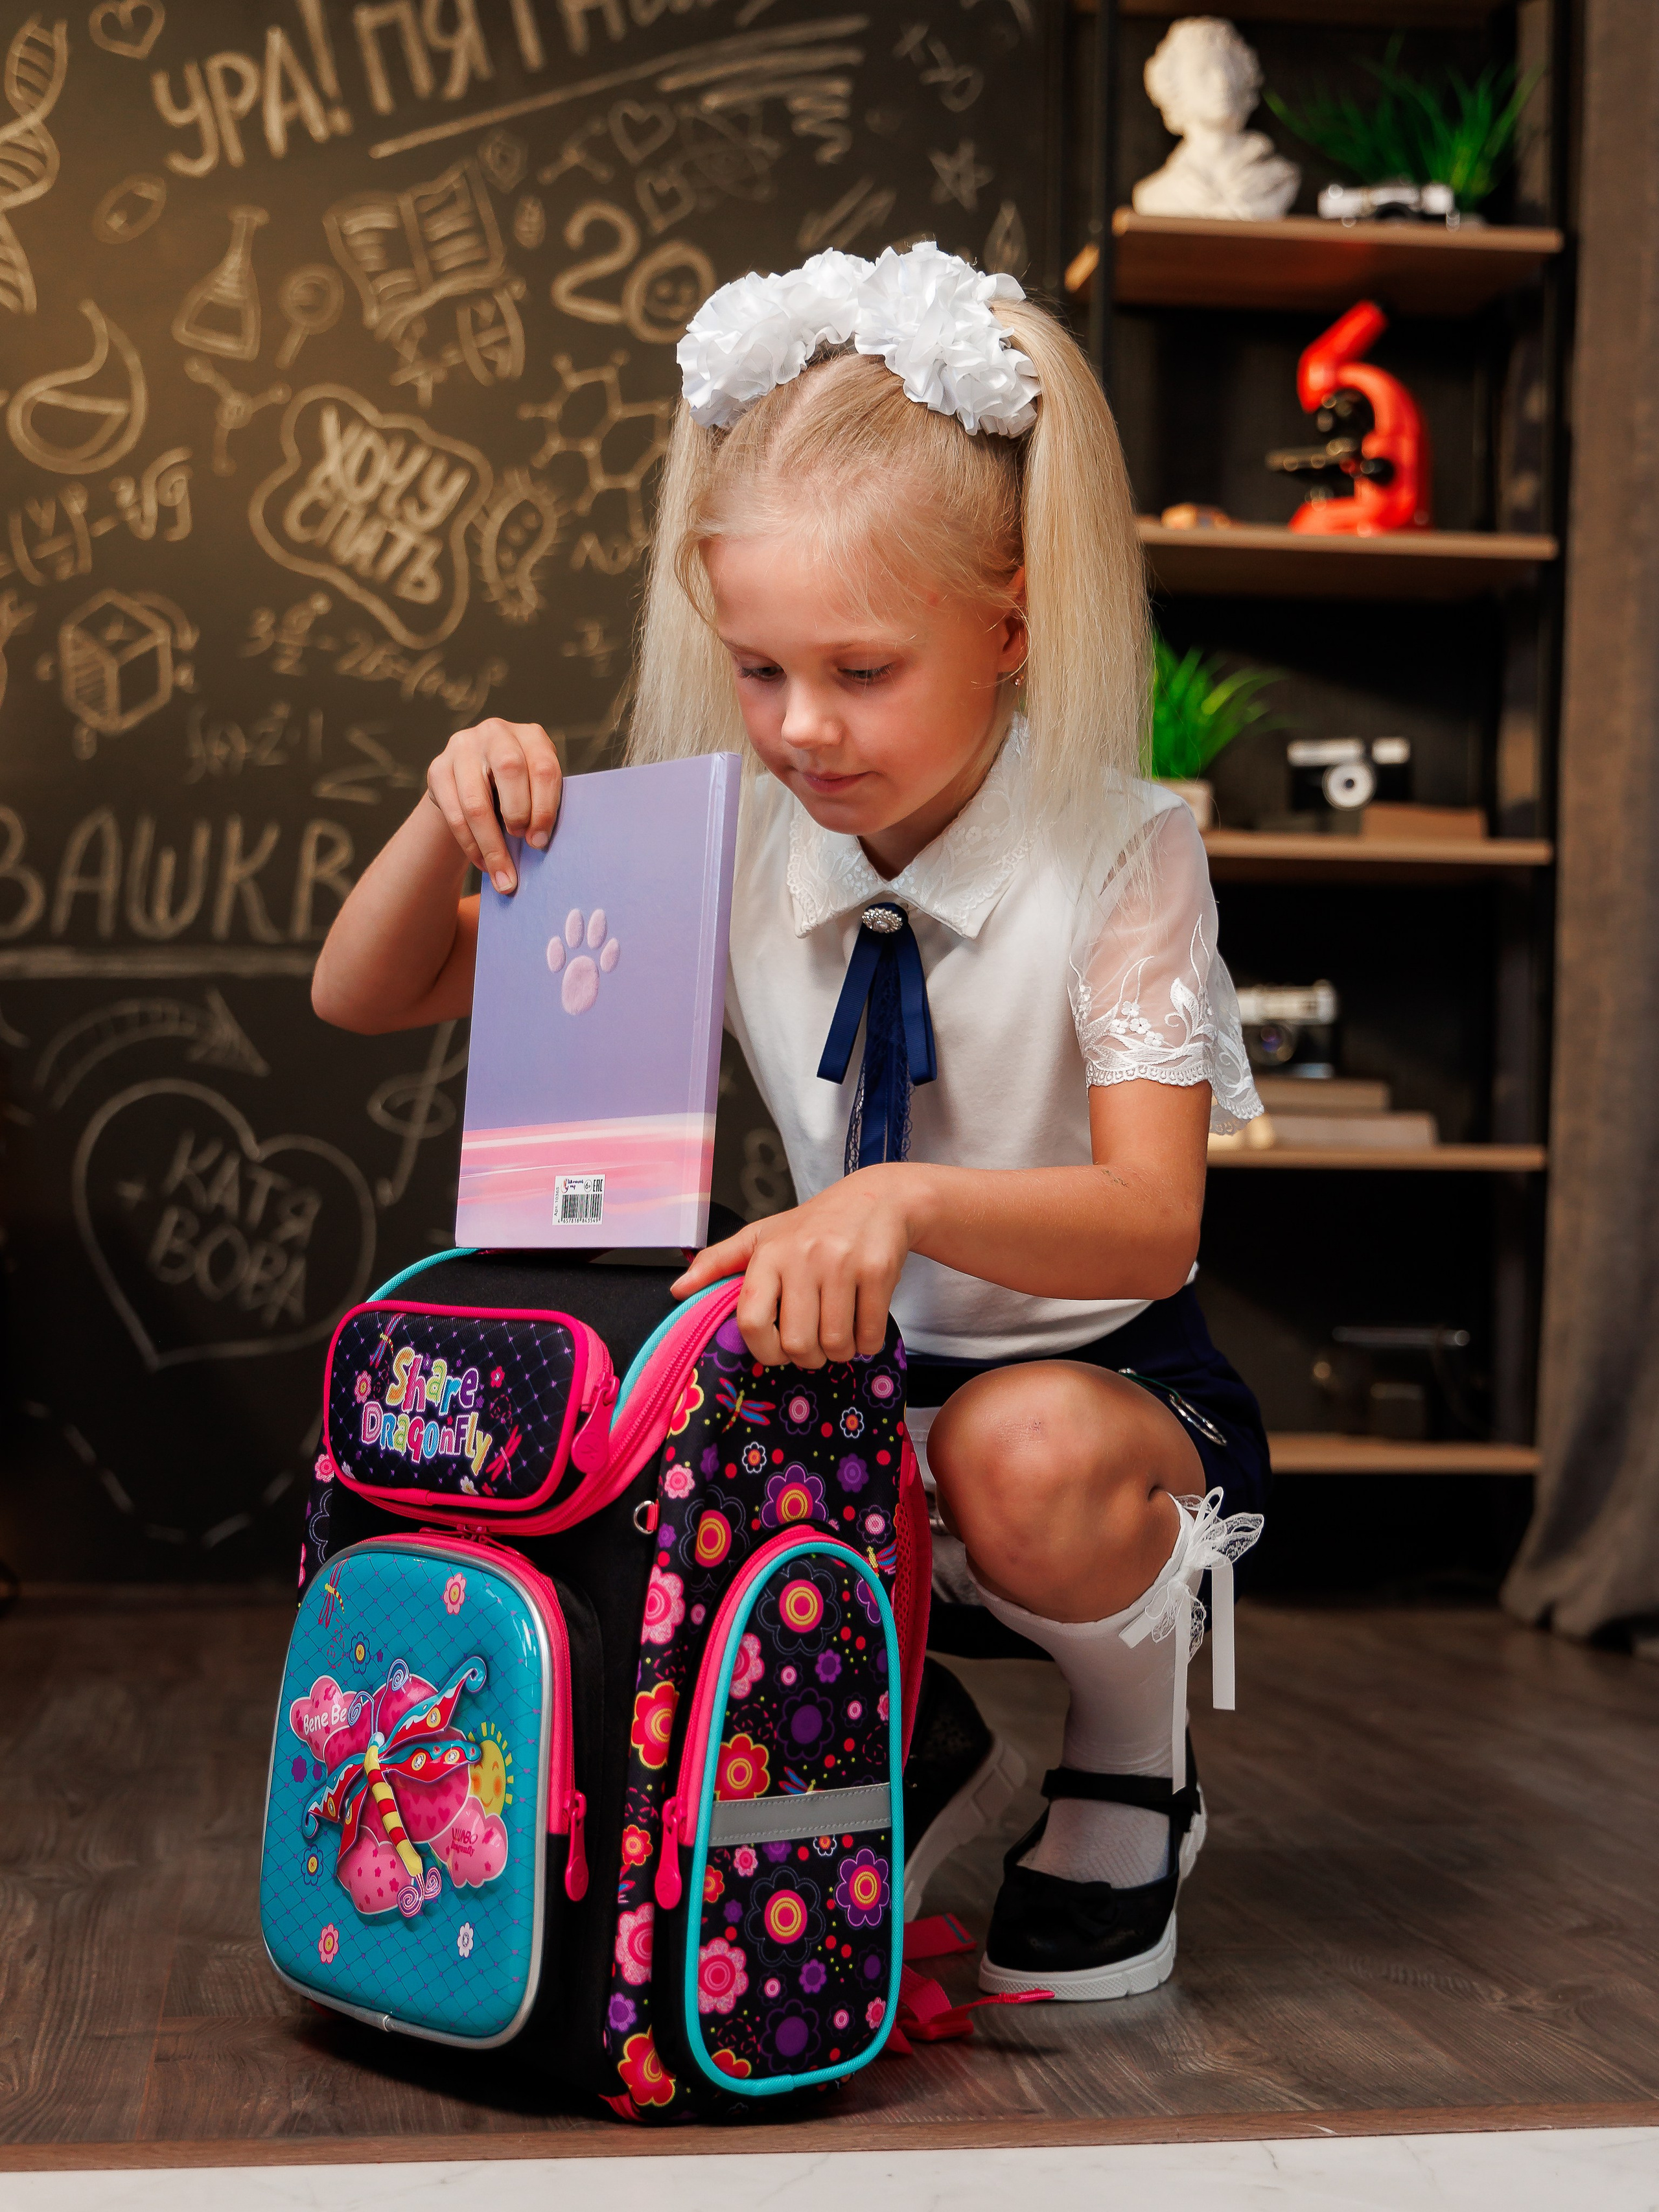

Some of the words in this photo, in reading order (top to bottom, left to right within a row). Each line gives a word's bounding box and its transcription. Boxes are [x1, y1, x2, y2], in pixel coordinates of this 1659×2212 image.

[307, 403, 472, 535] ХОЧУ
[282, 487, 443, 605] СПАТЬ
[163, 1131, 323, 1248] КАТЯ
[148, 1204, 307, 1325] ВОВА
[386, 1346, 480, 1417] Share
[303, 1713, 329, 1736] Bene
